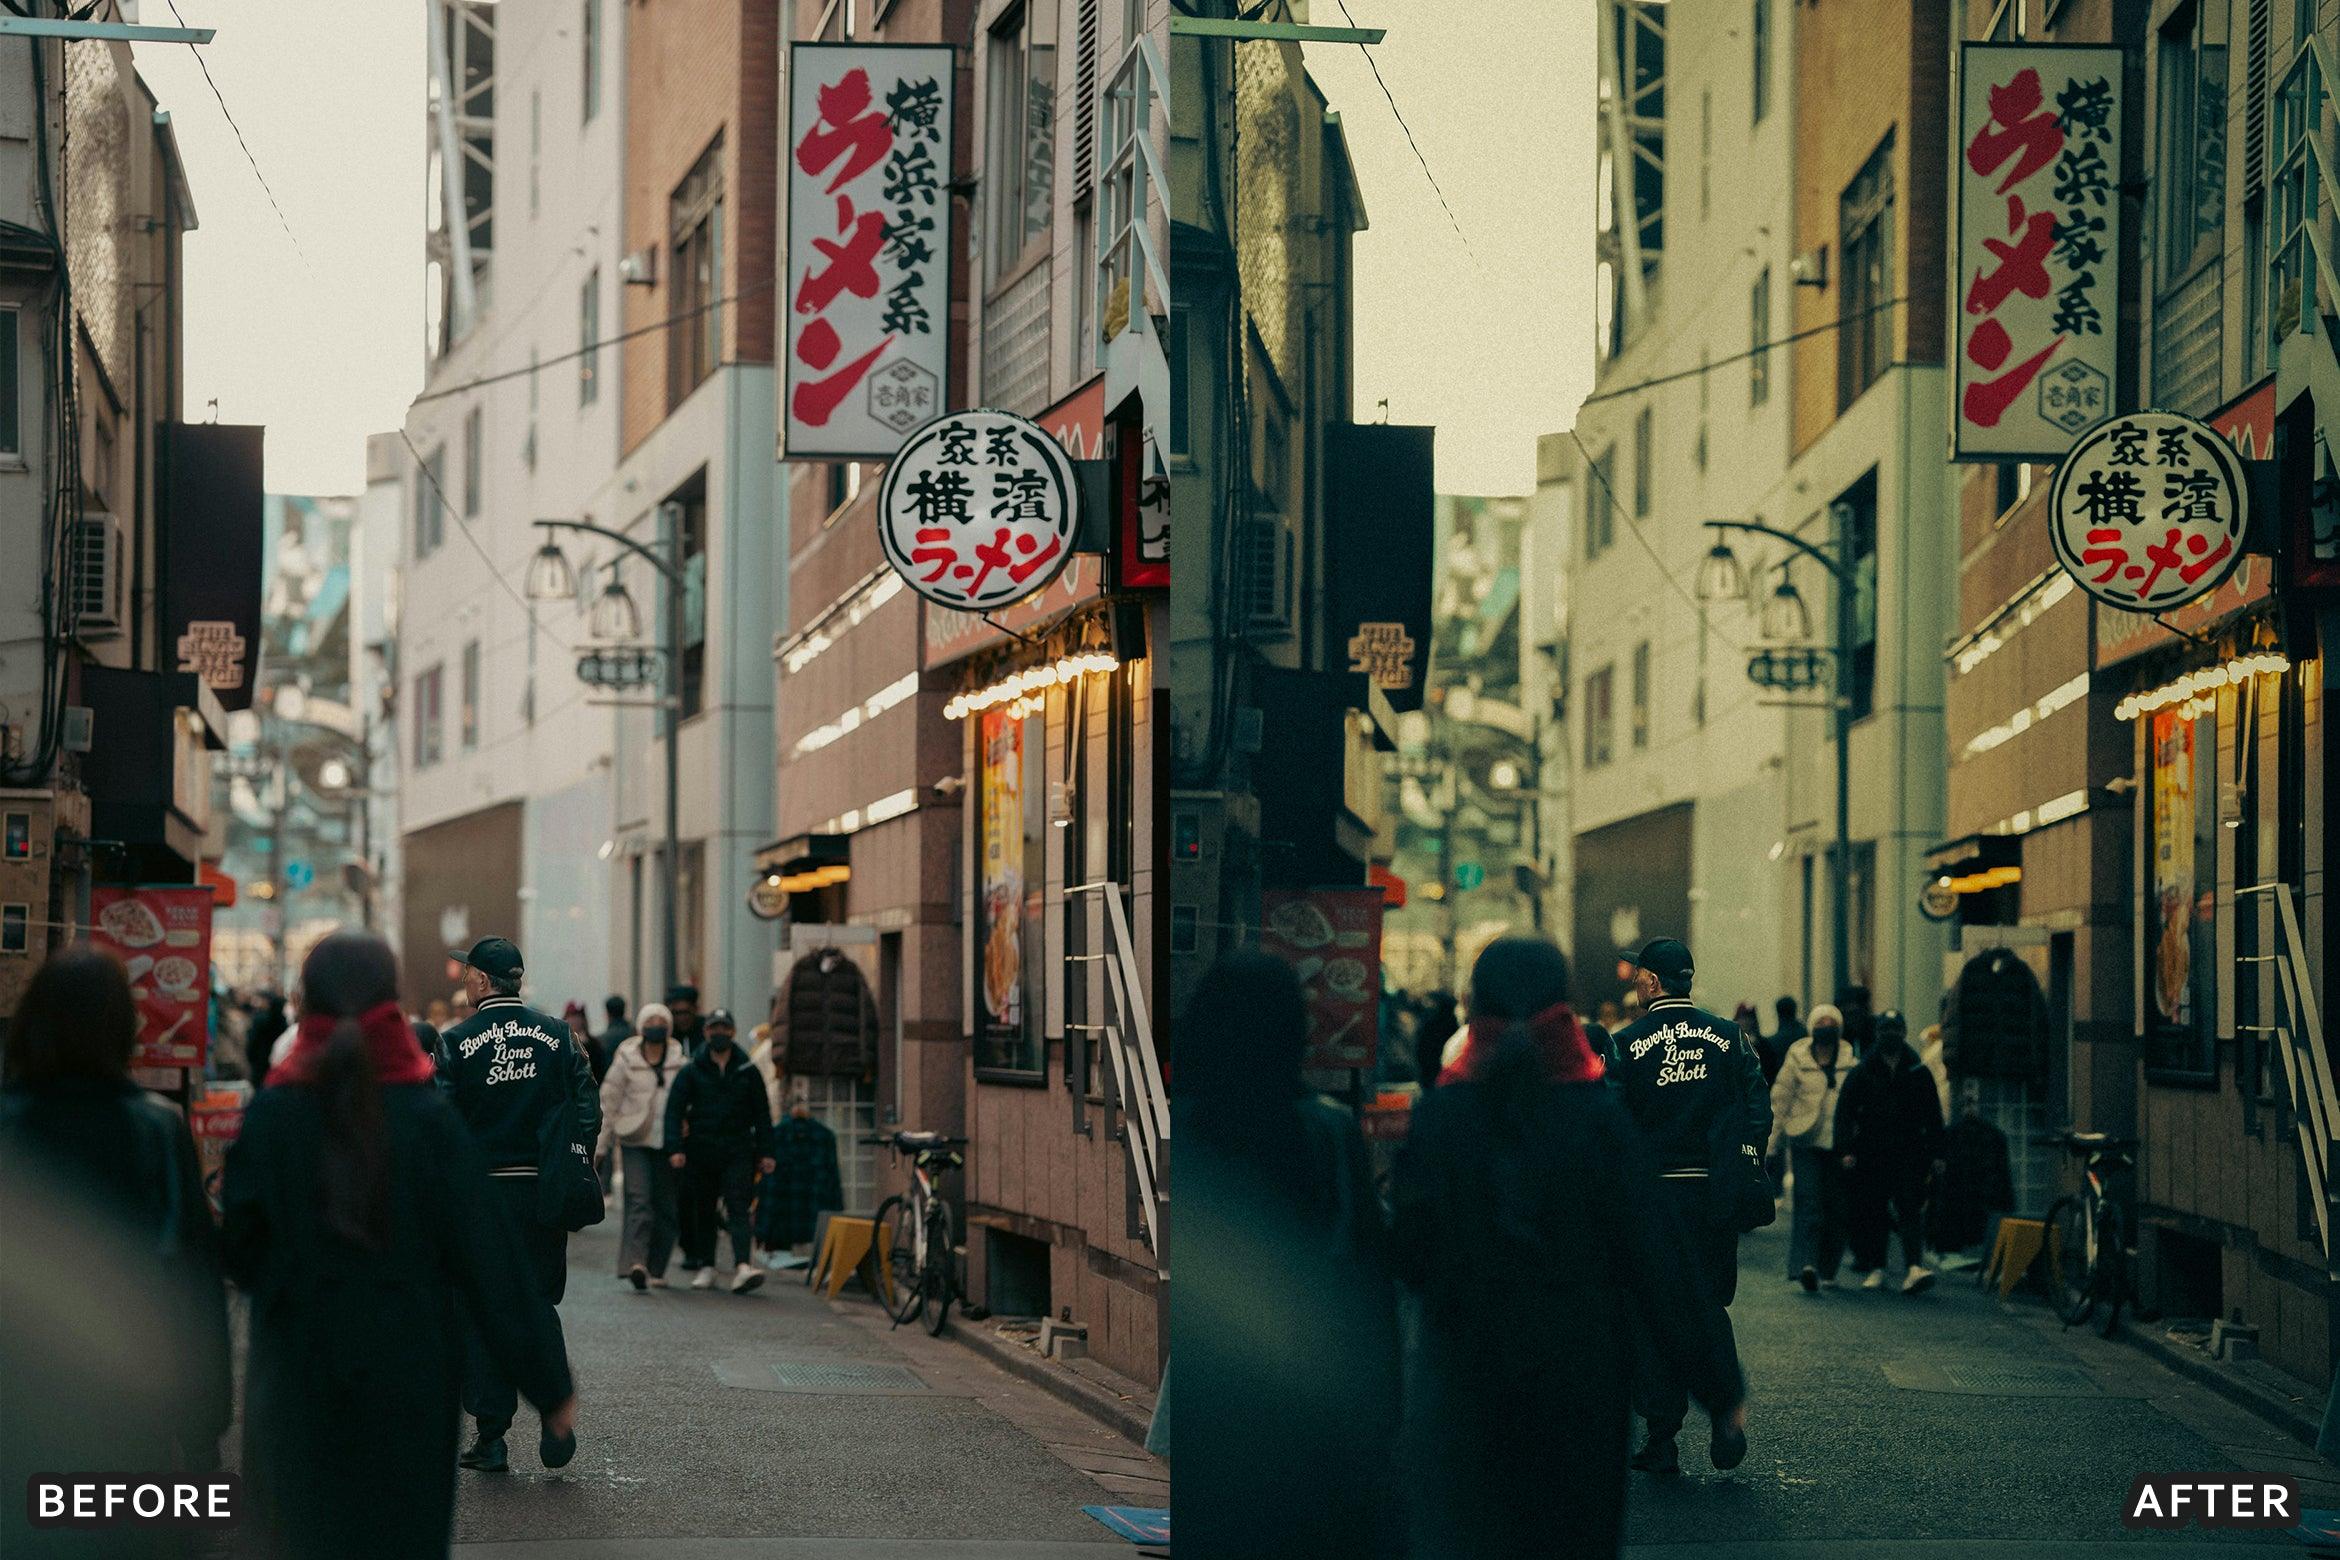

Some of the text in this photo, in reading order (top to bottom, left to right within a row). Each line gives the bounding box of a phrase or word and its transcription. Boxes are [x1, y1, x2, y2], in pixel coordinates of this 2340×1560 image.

[880, 75, 943, 336] 横浜家系
[2050, 76, 2115, 337] 横浜家系
[793, 67, 895, 427] ラーメン
[1964, 67, 2065, 427] ラーメン
[937, 421, 1019, 467] 家系
[2108, 421, 2190, 467] 家系
[901, 468, 1052, 526] 横濱
[2072, 468, 2224, 526] 横濱
[911, 528, 1061, 598] ラーメン
[2082, 528, 2232, 598] ラーメン
[486, 1061, 537, 1085] Schott
[491, 1043, 534, 1064] Lions
[1656, 1062, 1708, 1086] Schott
[1662, 1044, 1704, 1065] Lions
